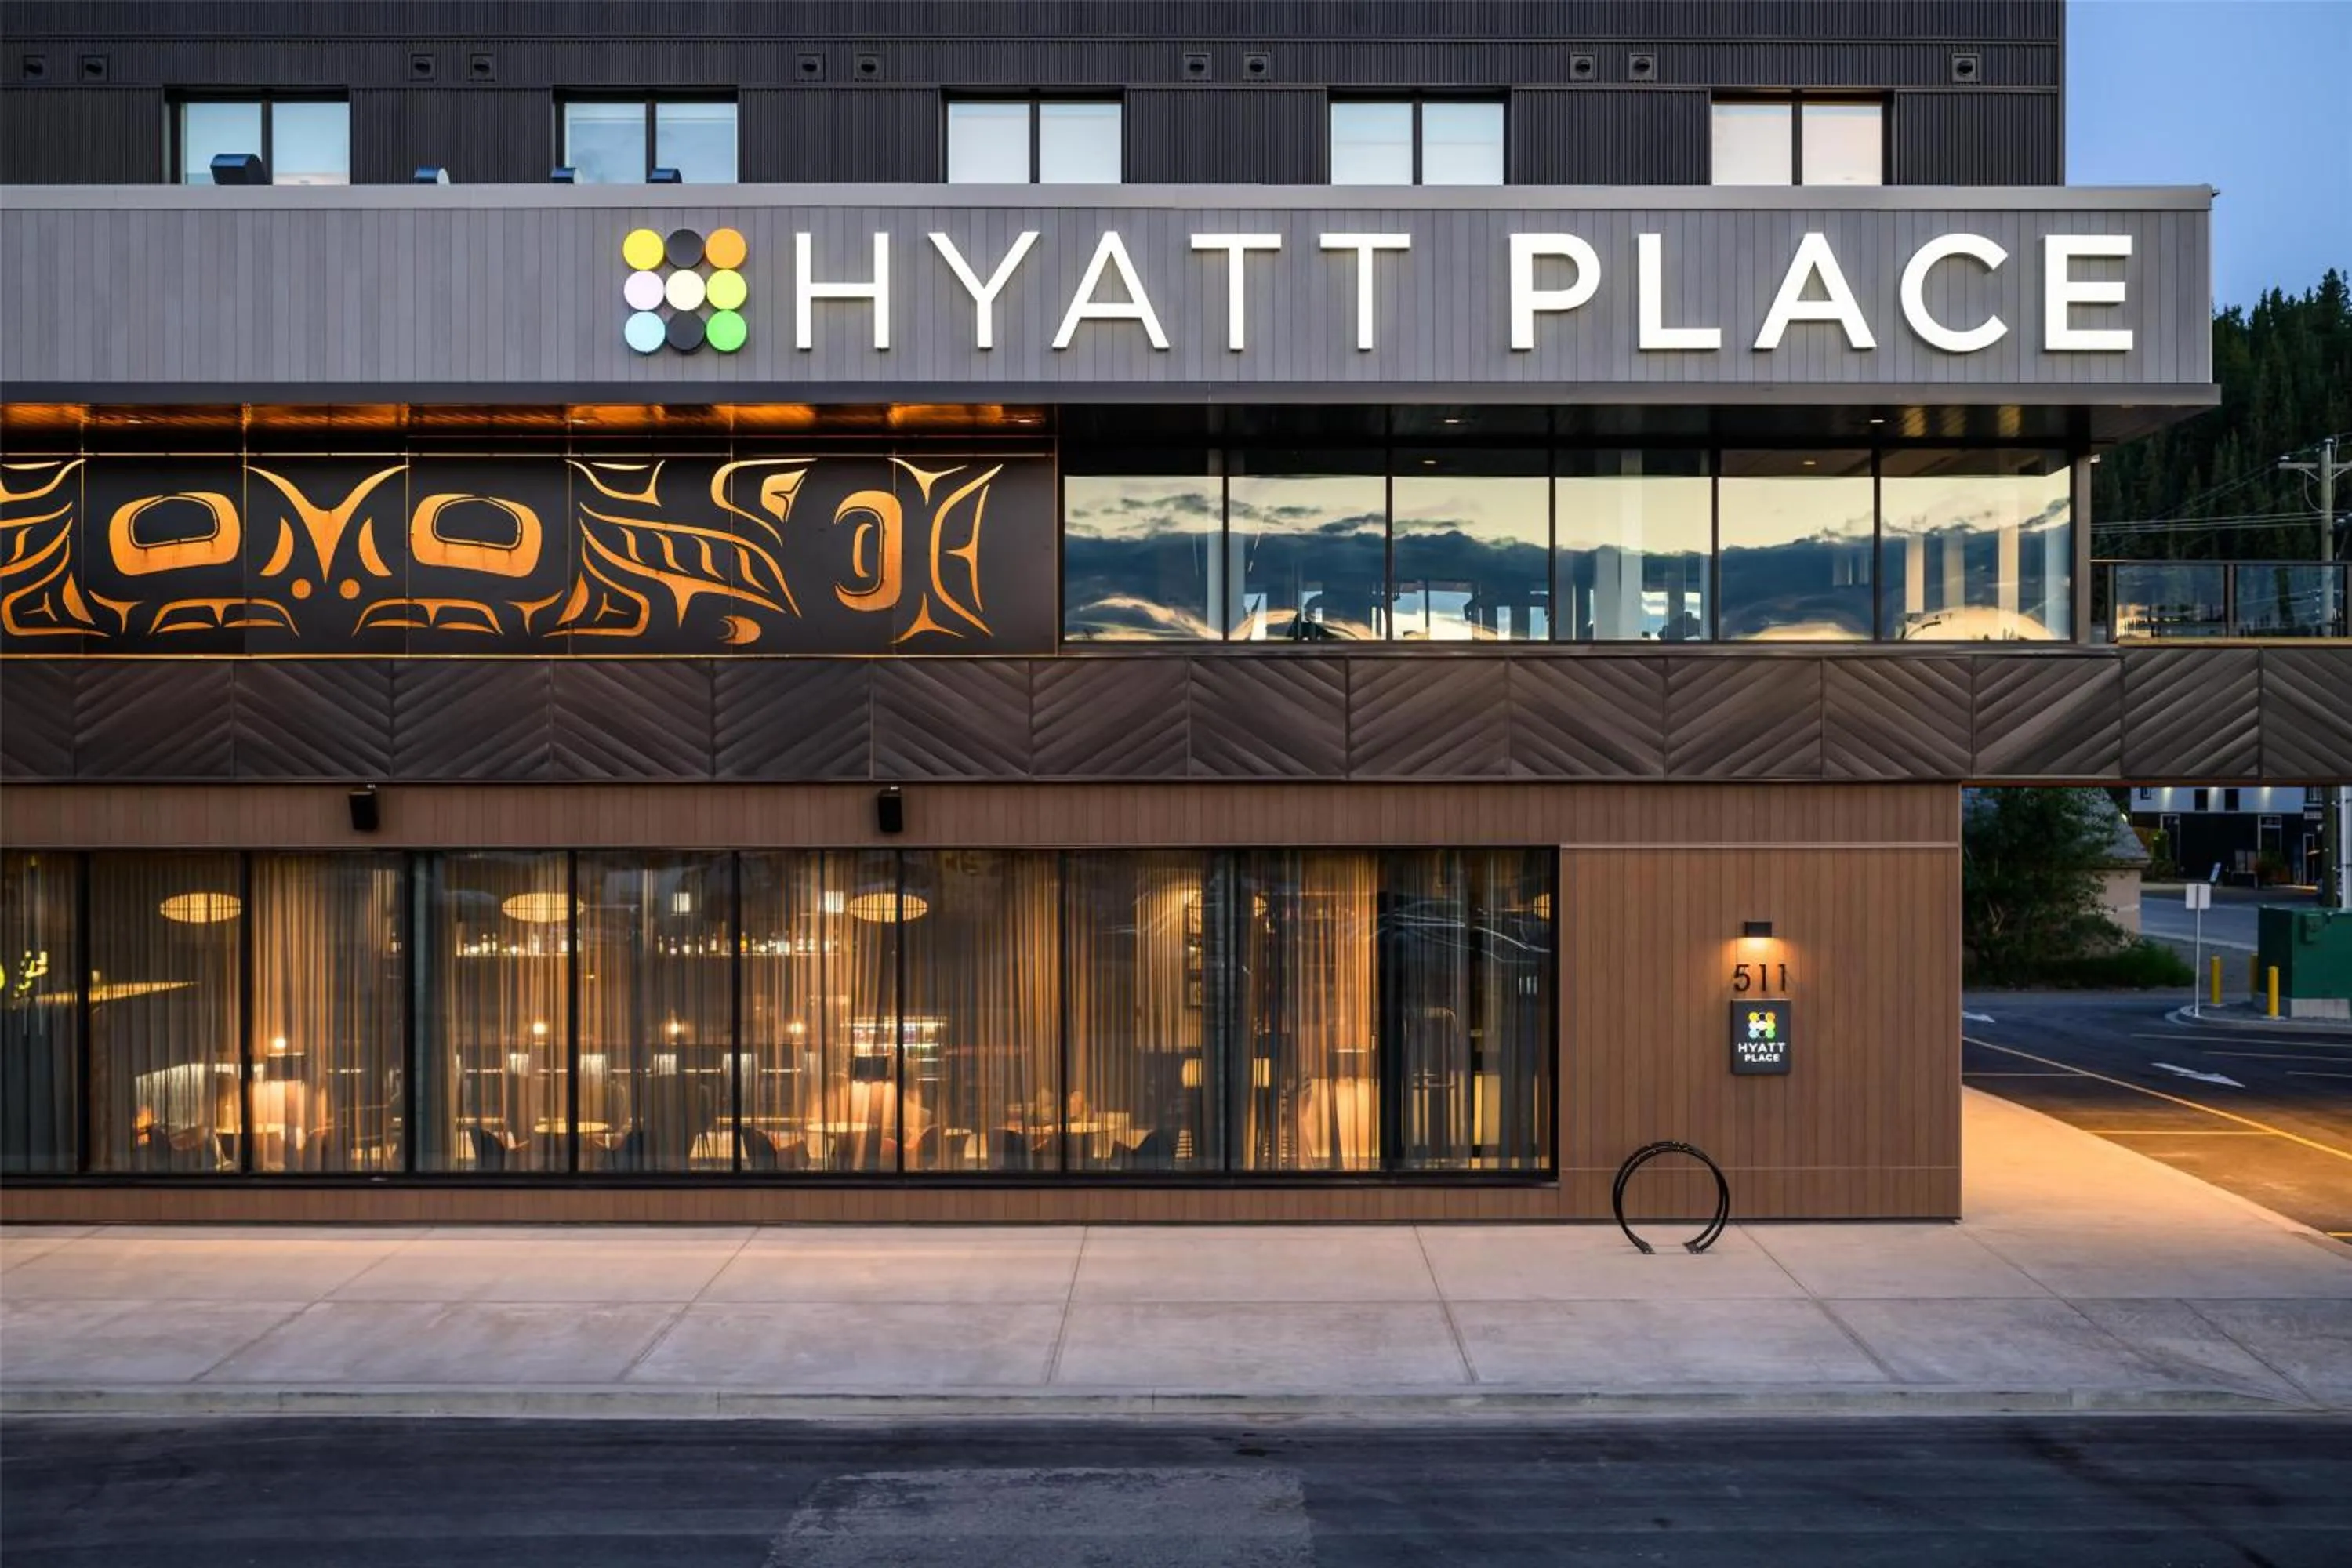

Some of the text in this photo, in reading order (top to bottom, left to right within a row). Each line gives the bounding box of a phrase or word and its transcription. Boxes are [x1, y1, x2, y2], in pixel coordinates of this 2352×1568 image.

[794, 230, 2136, 352] HYATT PLACE
[1733, 964, 1787, 992] 511
[1737, 1042, 1786, 1053] HYATT
[1744, 1053, 1780, 1062] PLACE
